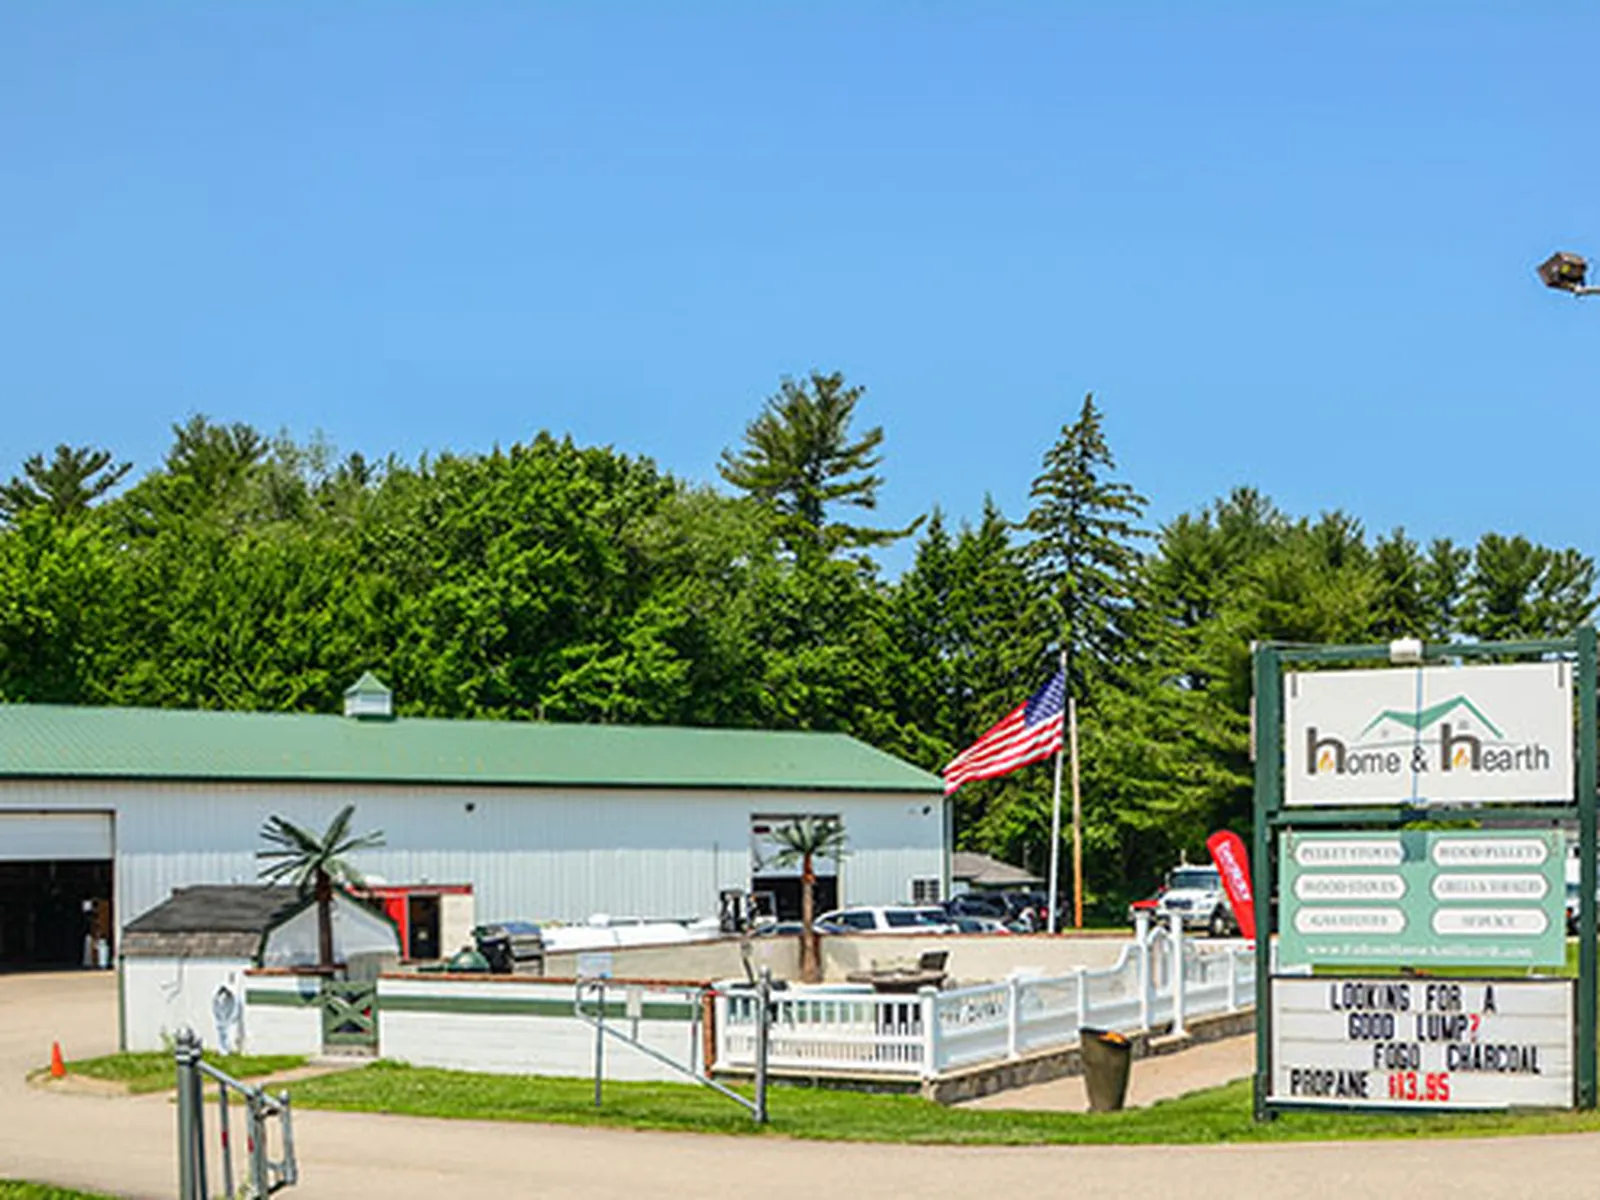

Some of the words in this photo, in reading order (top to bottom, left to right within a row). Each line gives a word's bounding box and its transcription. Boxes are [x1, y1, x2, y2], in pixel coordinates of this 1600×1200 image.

[1306, 726, 1400, 775] home
[1410, 746, 1428, 774] &
[1441, 722, 1549, 772] hearth
[1330, 983, 1410, 1012] LOOKING
[1425, 984, 1462, 1011] FOR
[1483, 985, 1497, 1013] A
[1348, 1013, 1394, 1040] GOOD
[1416, 1013, 1481, 1042] LUMP?
[1373, 1042, 1421, 1070] FOGO
[1446, 1045, 1541, 1074] CHARCOAL
[1290, 1069, 1369, 1098] PROPANE
